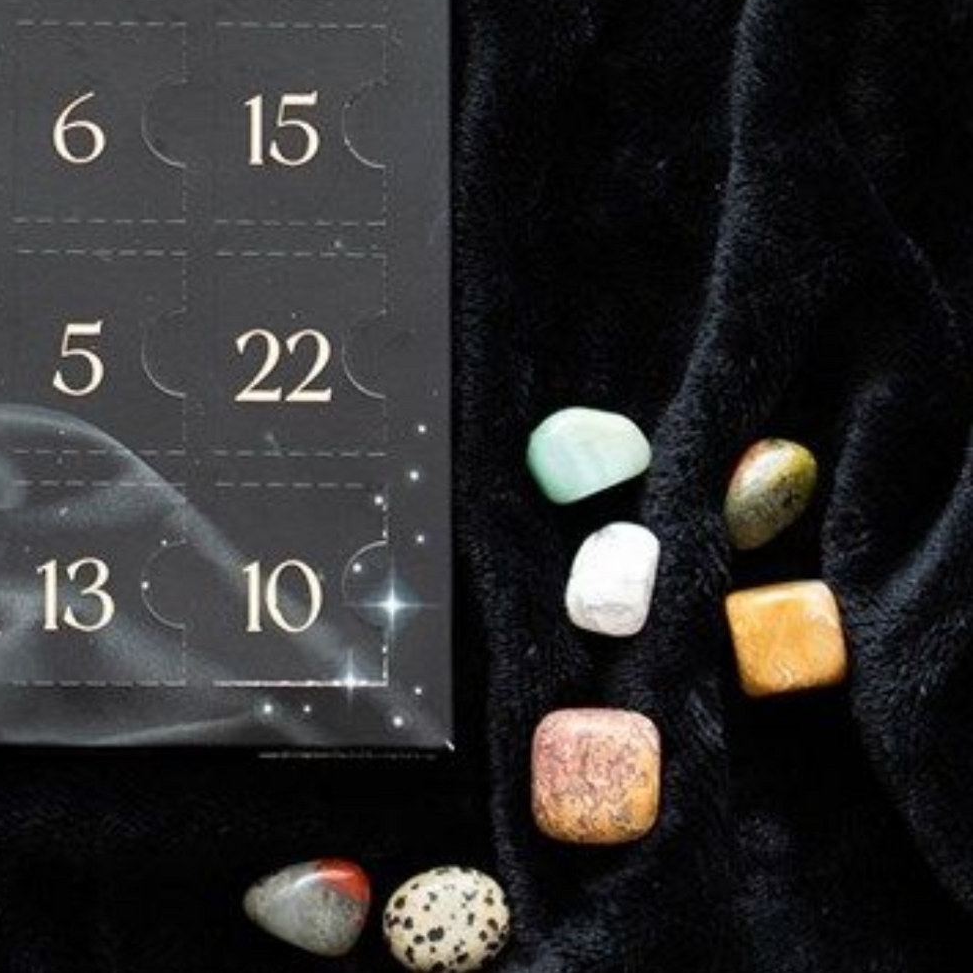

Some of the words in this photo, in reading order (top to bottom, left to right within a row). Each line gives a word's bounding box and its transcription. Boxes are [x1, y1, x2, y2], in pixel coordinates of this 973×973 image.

[53, 91, 106, 164] 6
[244, 90, 320, 166] 15
[52, 320, 104, 397] 5
[234, 328, 333, 403] 22
[36, 557, 115, 632] 13
[241, 559, 323, 633] 10
